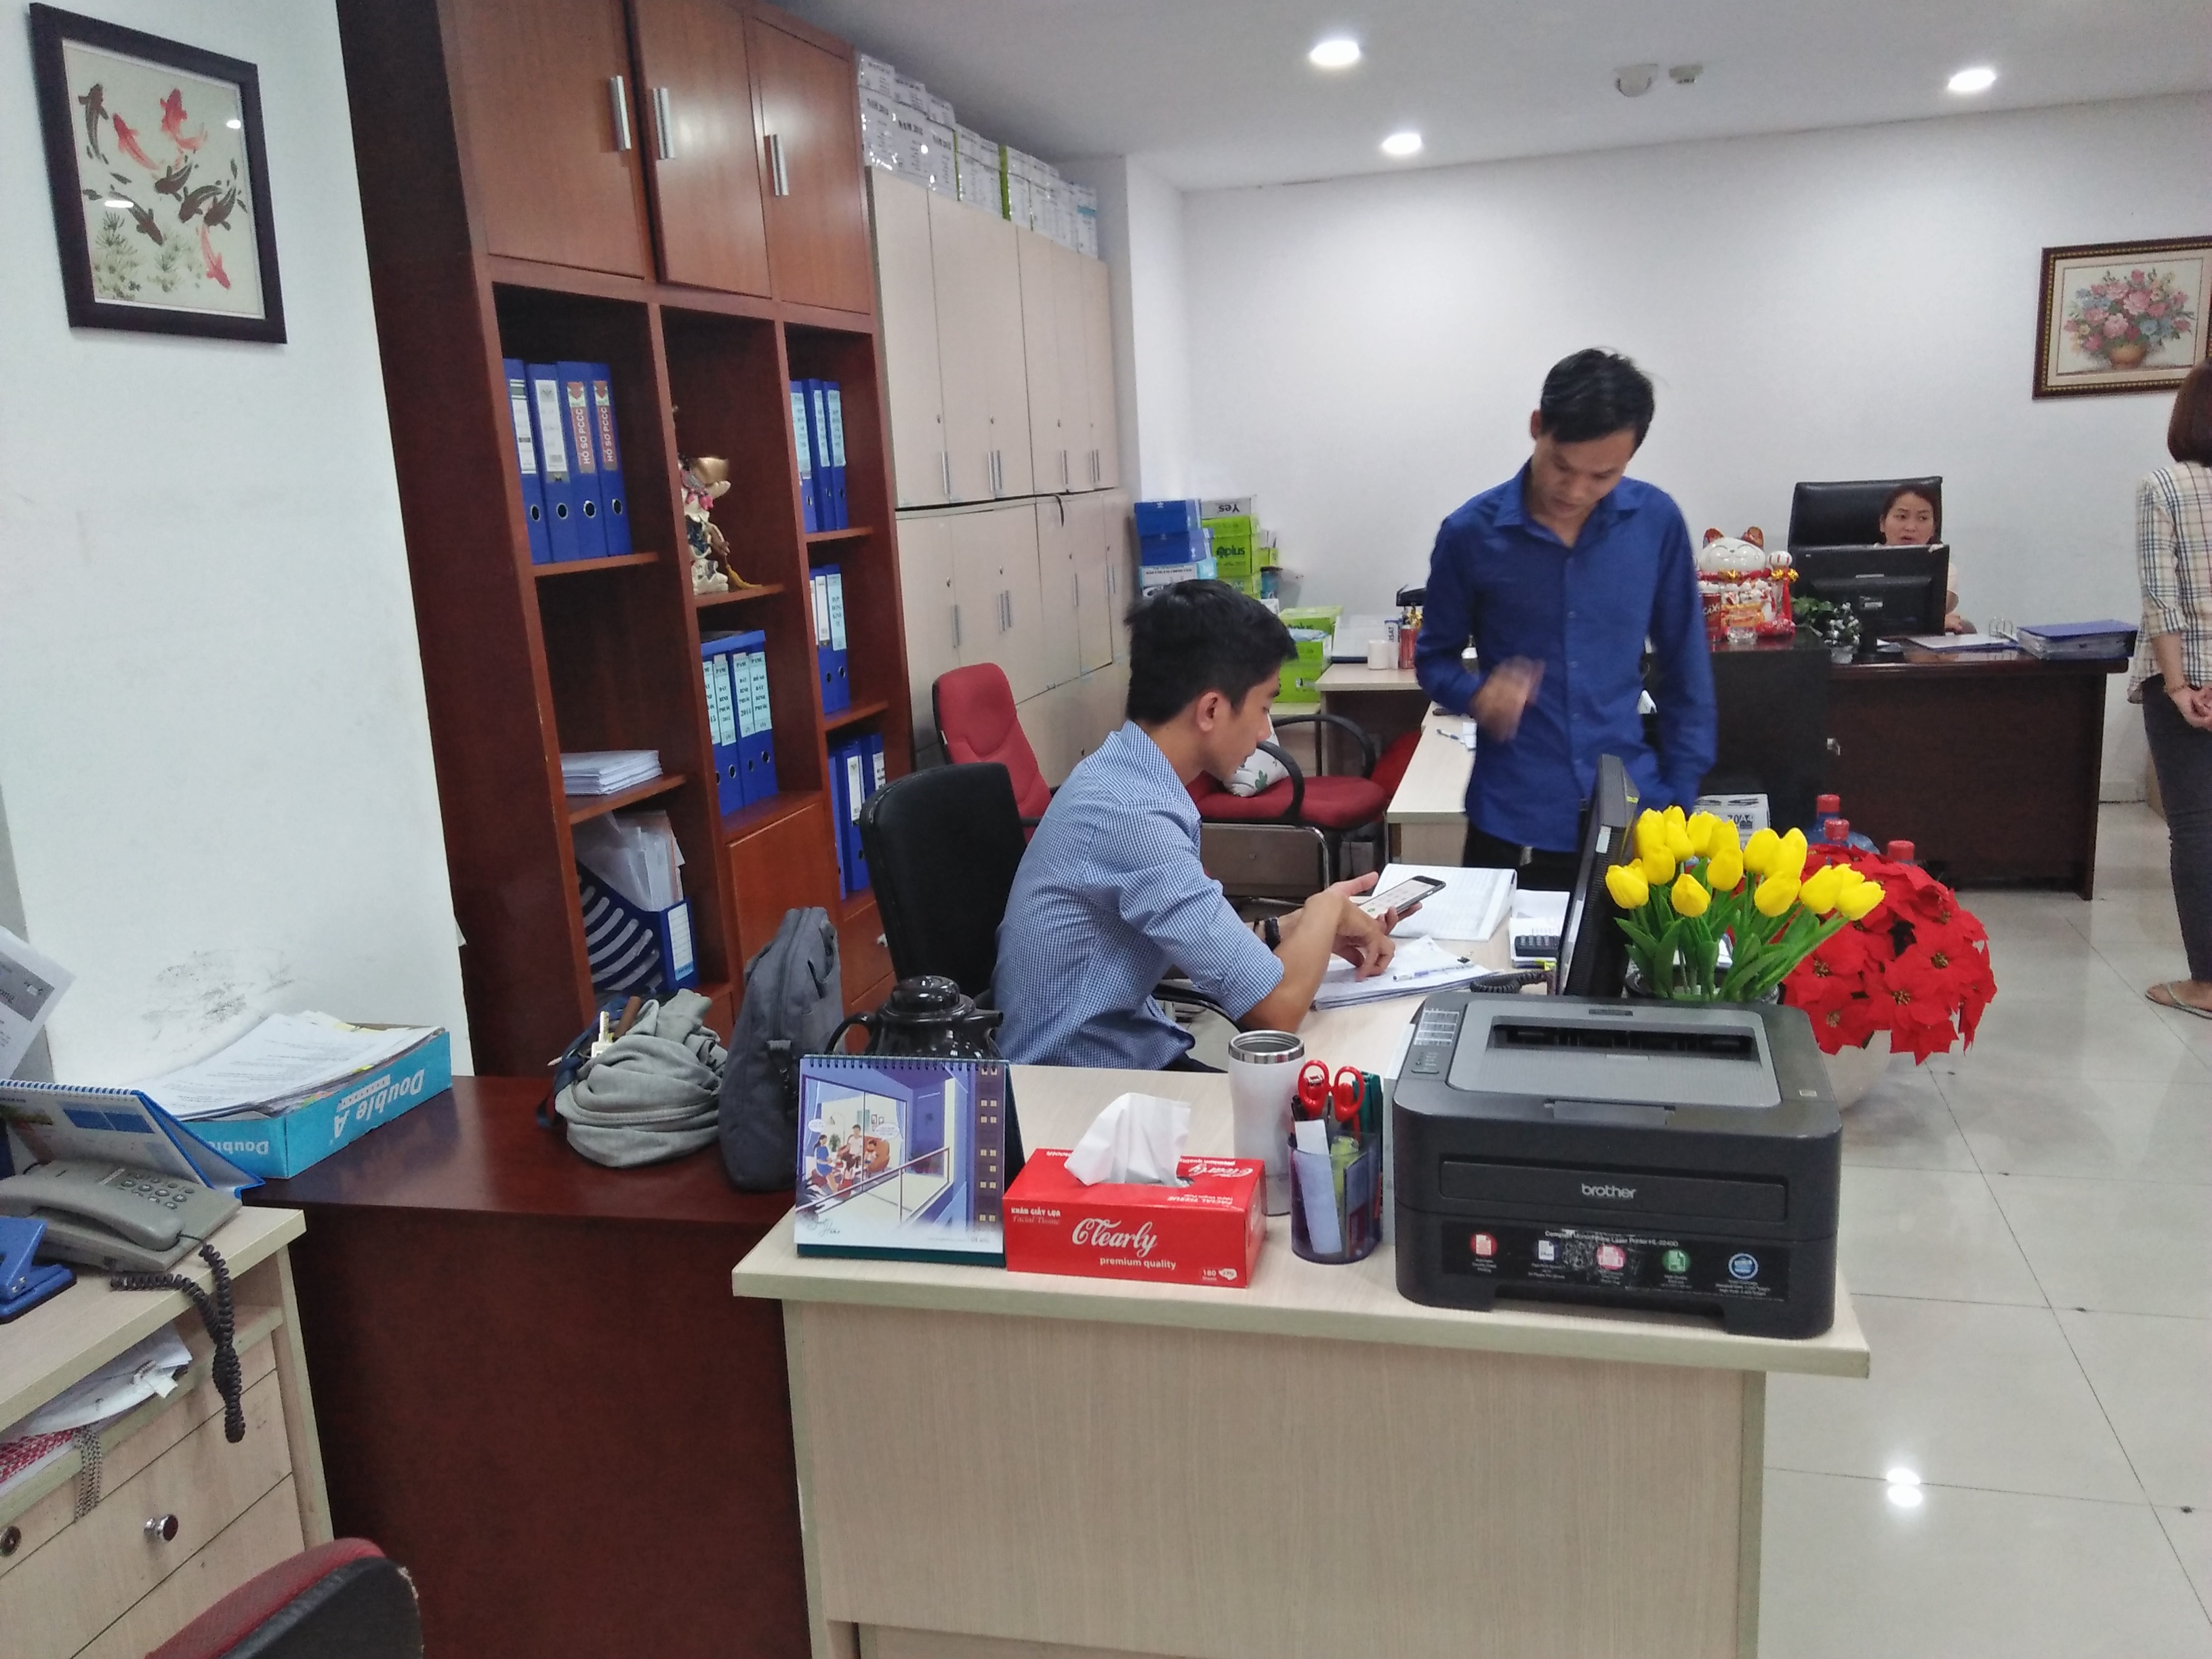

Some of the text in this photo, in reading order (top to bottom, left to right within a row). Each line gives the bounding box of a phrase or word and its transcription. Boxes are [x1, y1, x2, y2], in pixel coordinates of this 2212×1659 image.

[575, 408, 586, 434] PCCC
[600, 407, 610, 432] PCCC
[1218, 504, 1240, 514] Yes
[356, 1069, 425, 1121] Double
[333, 1109, 351, 1139] A
[1581, 1183, 1637, 1199] brother
[1072, 1218, 1158, 1258] Clearly
[1099, 1256, 1176, 1271] premium quality
